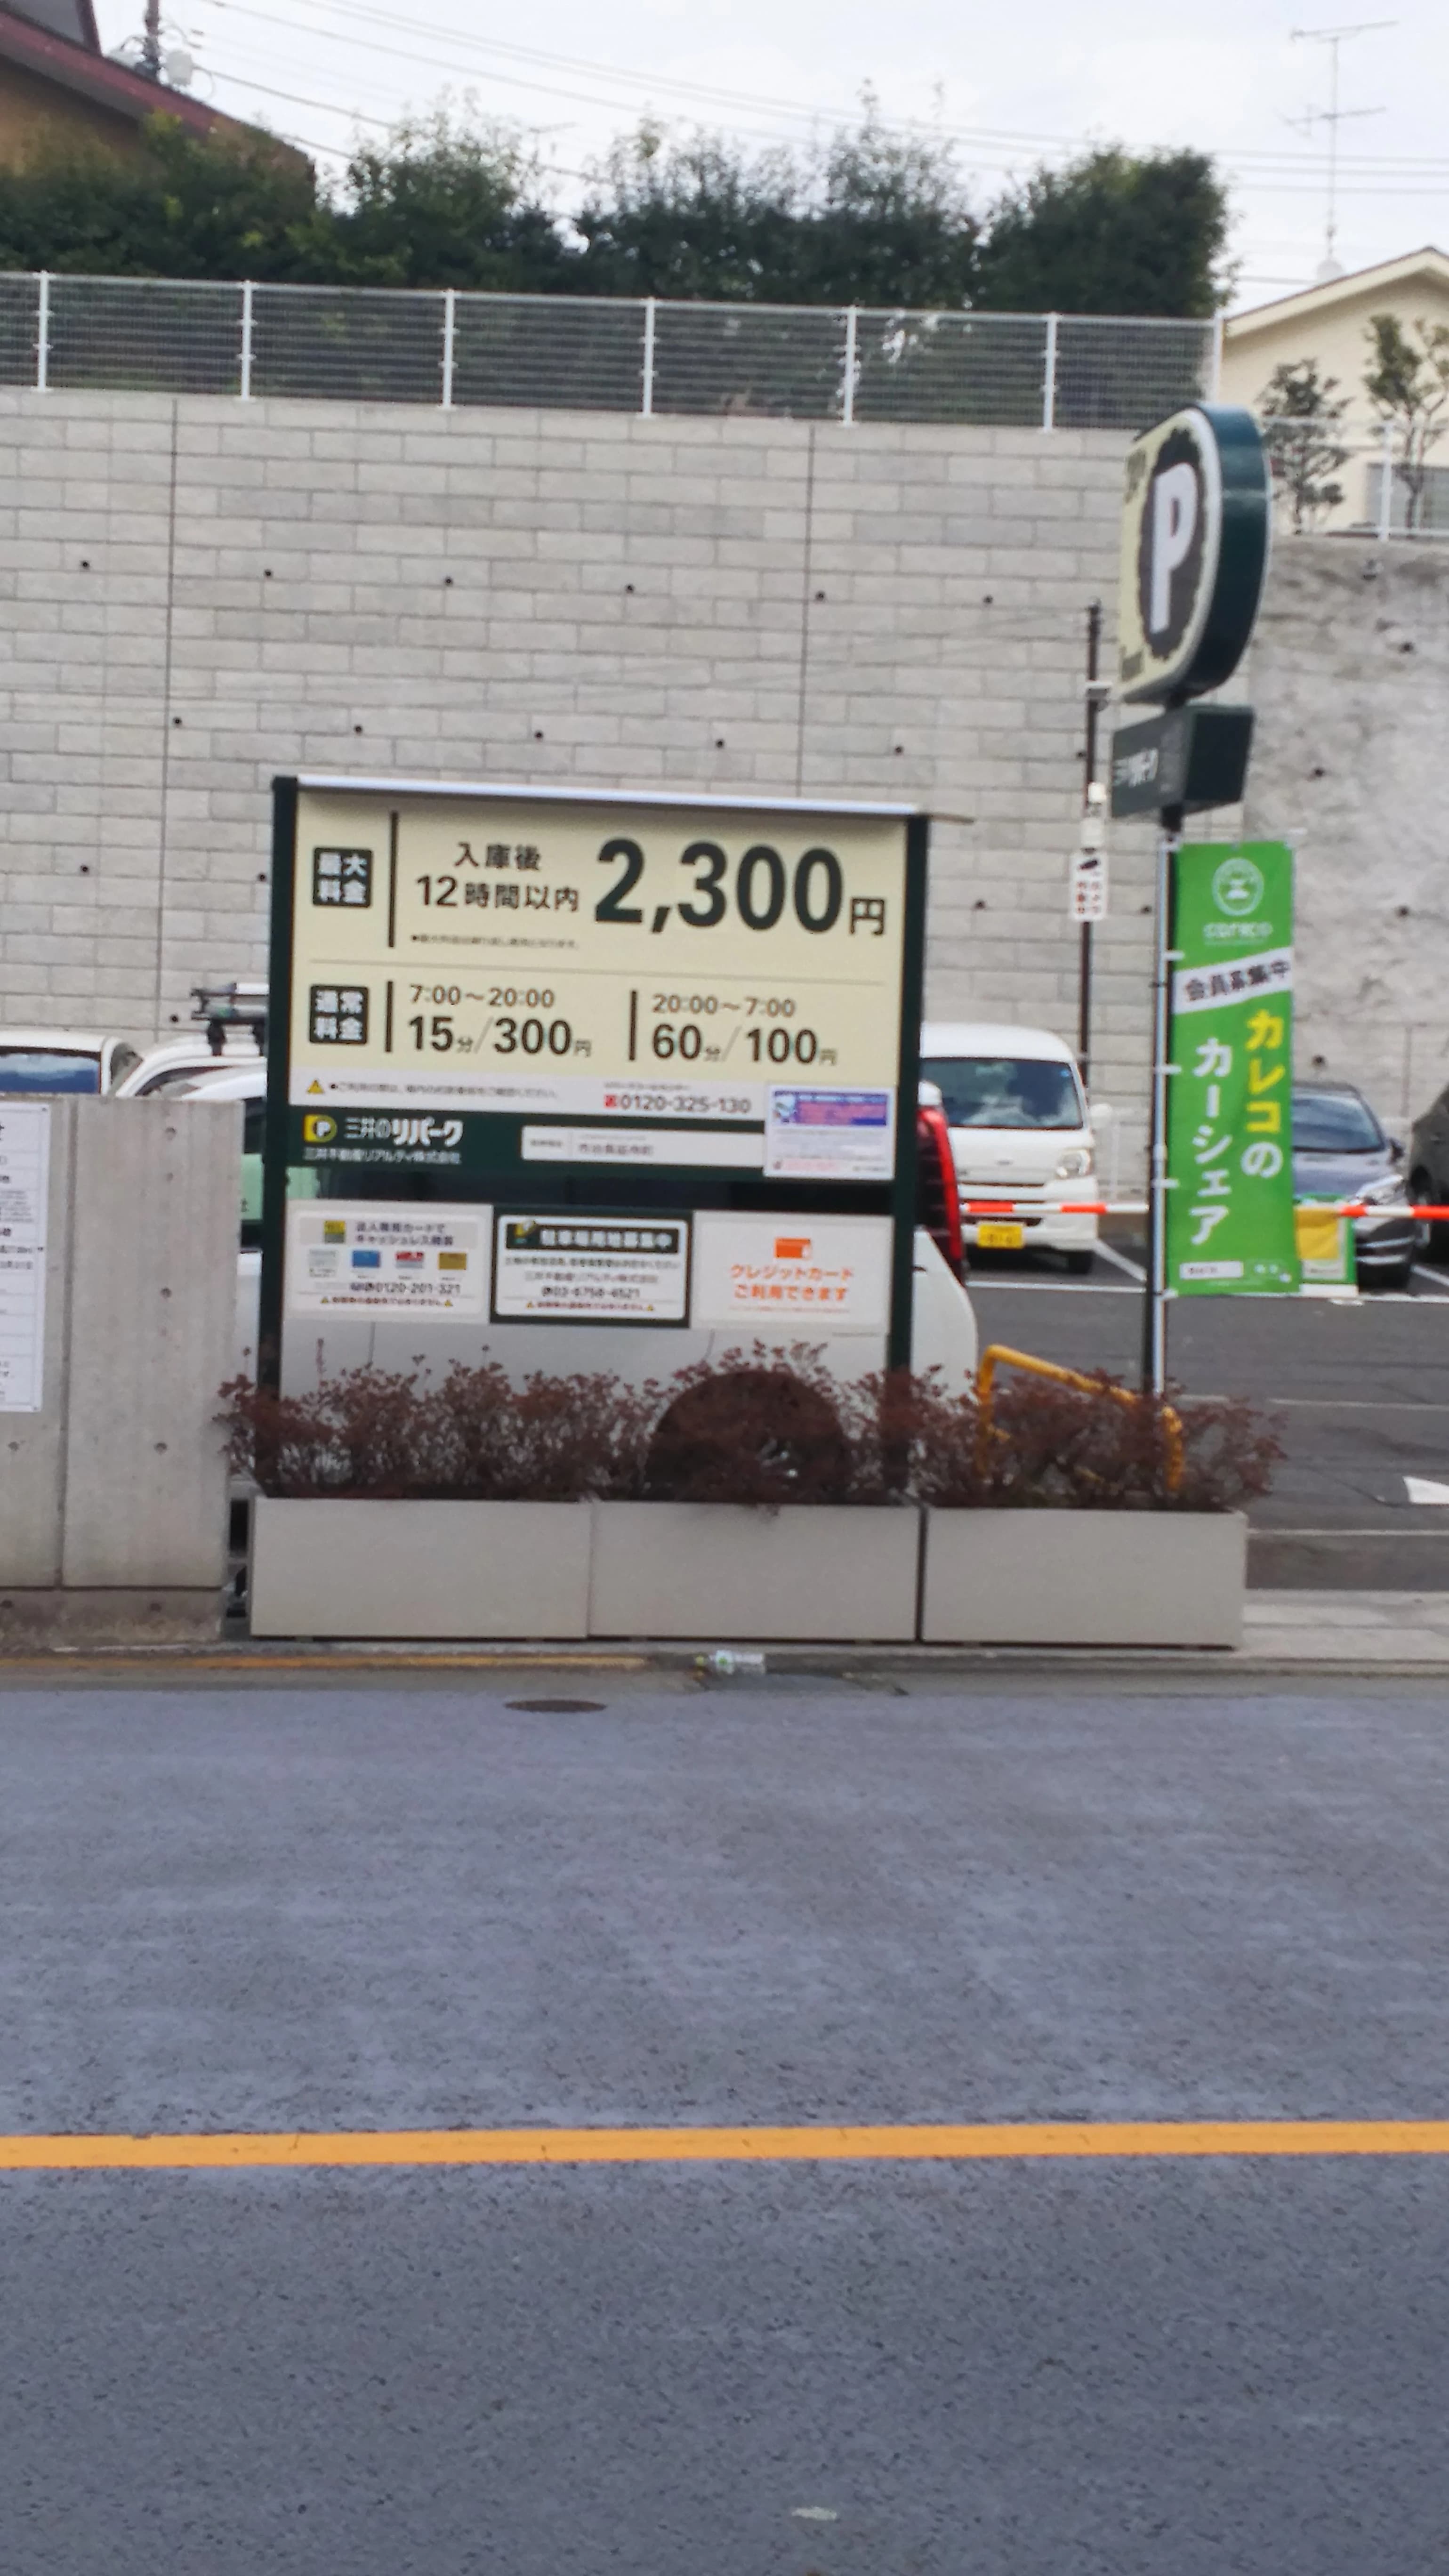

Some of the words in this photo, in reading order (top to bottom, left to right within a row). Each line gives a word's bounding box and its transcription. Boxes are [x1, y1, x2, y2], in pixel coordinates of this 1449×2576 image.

[1150, 462, 1198, 634] P
[455, 842, 541, 871] 入庫後
[417, 875, 579, 912] 12時間以内
[620, 1094, 751, 1114] 0120-325-130
[1241, 1009, 1286, 1178] カレコの
[1189, 1038, 1232, 1246] カーシェア
[731, 1264, 852, 1281] クレジットカード
[735, 1285, 847, 1302] ご利用できます
